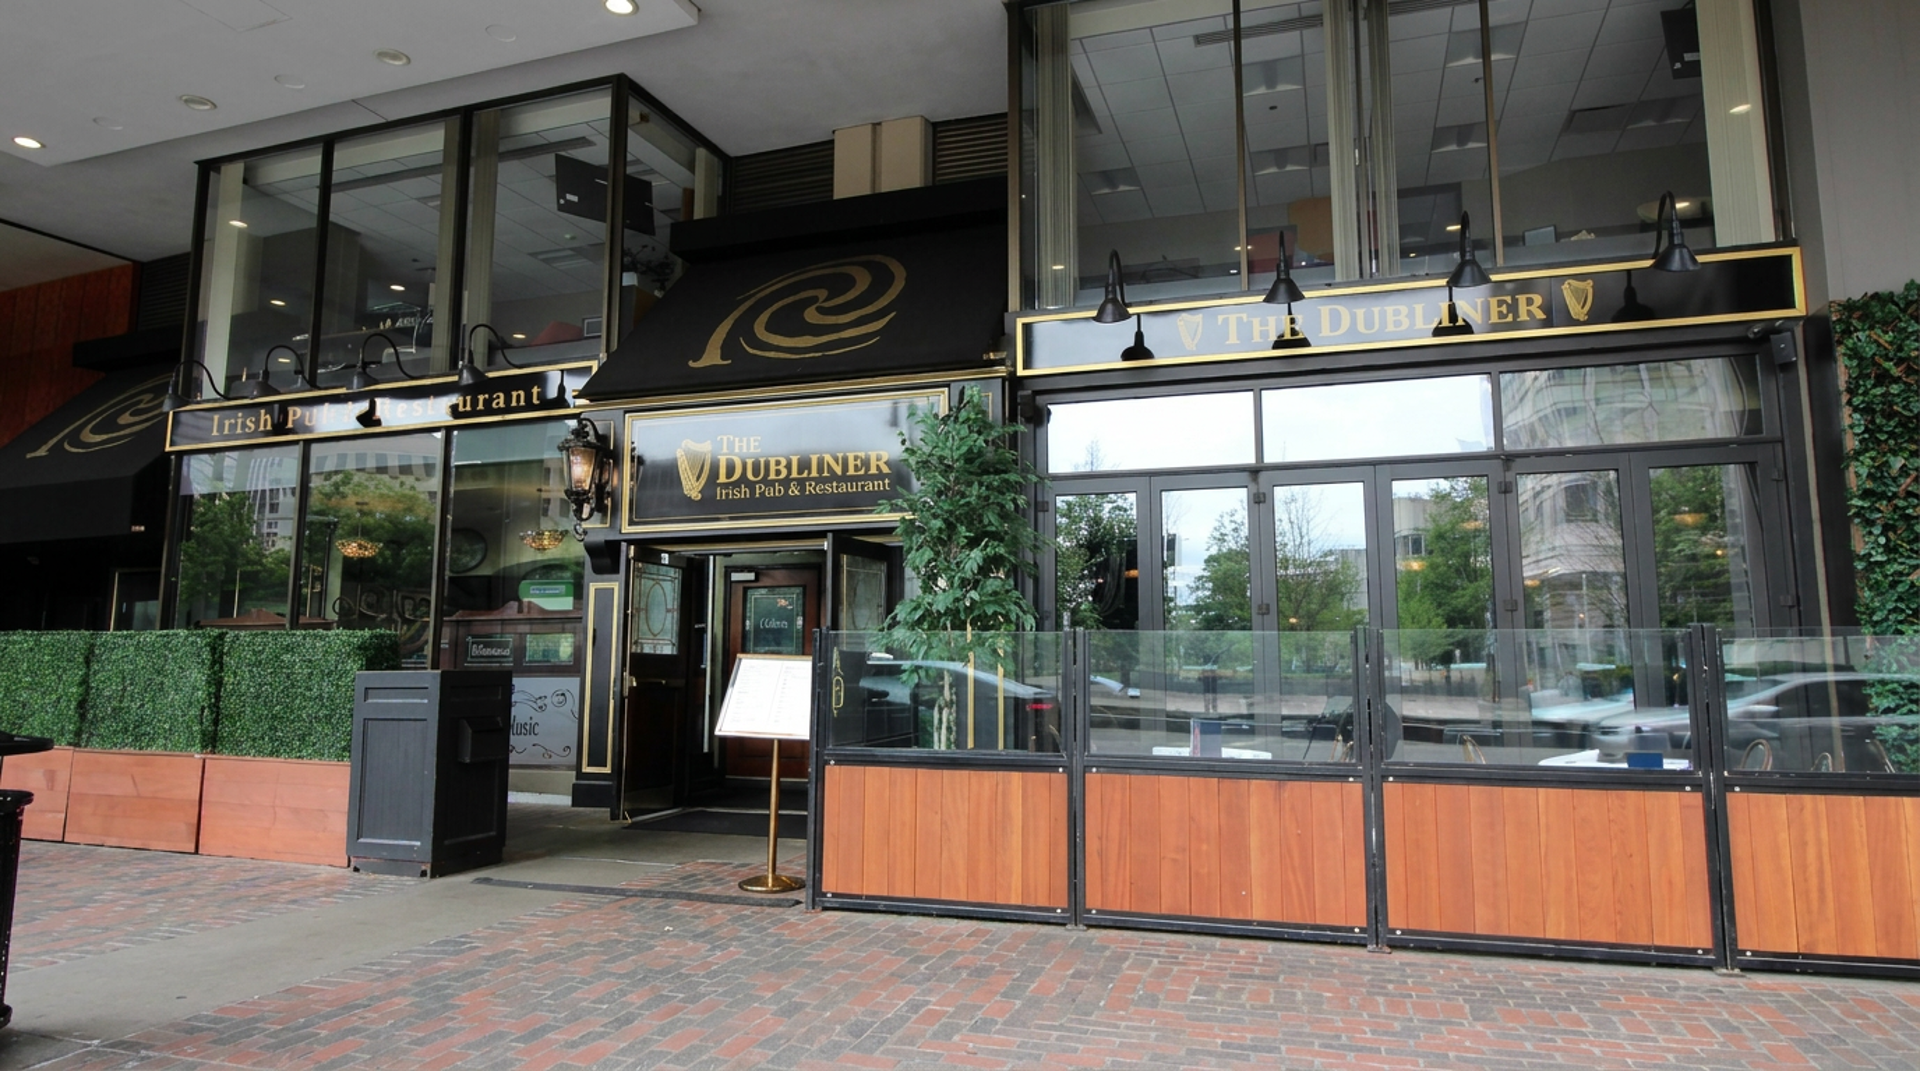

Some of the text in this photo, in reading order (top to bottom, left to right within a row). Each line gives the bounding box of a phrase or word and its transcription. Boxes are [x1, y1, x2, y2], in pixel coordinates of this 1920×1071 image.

[1218, 293, 1547, 344] THE DUBLINER
[211, 409, 273, 436] Irish
[717, 434, 761, 453] THE
[716, 451, 892, 484] DUBLINER
[716, 483, 750, 500] Irish
[788, 481, 801, 496] &
[805, 478, 891, 496] Restaurant
